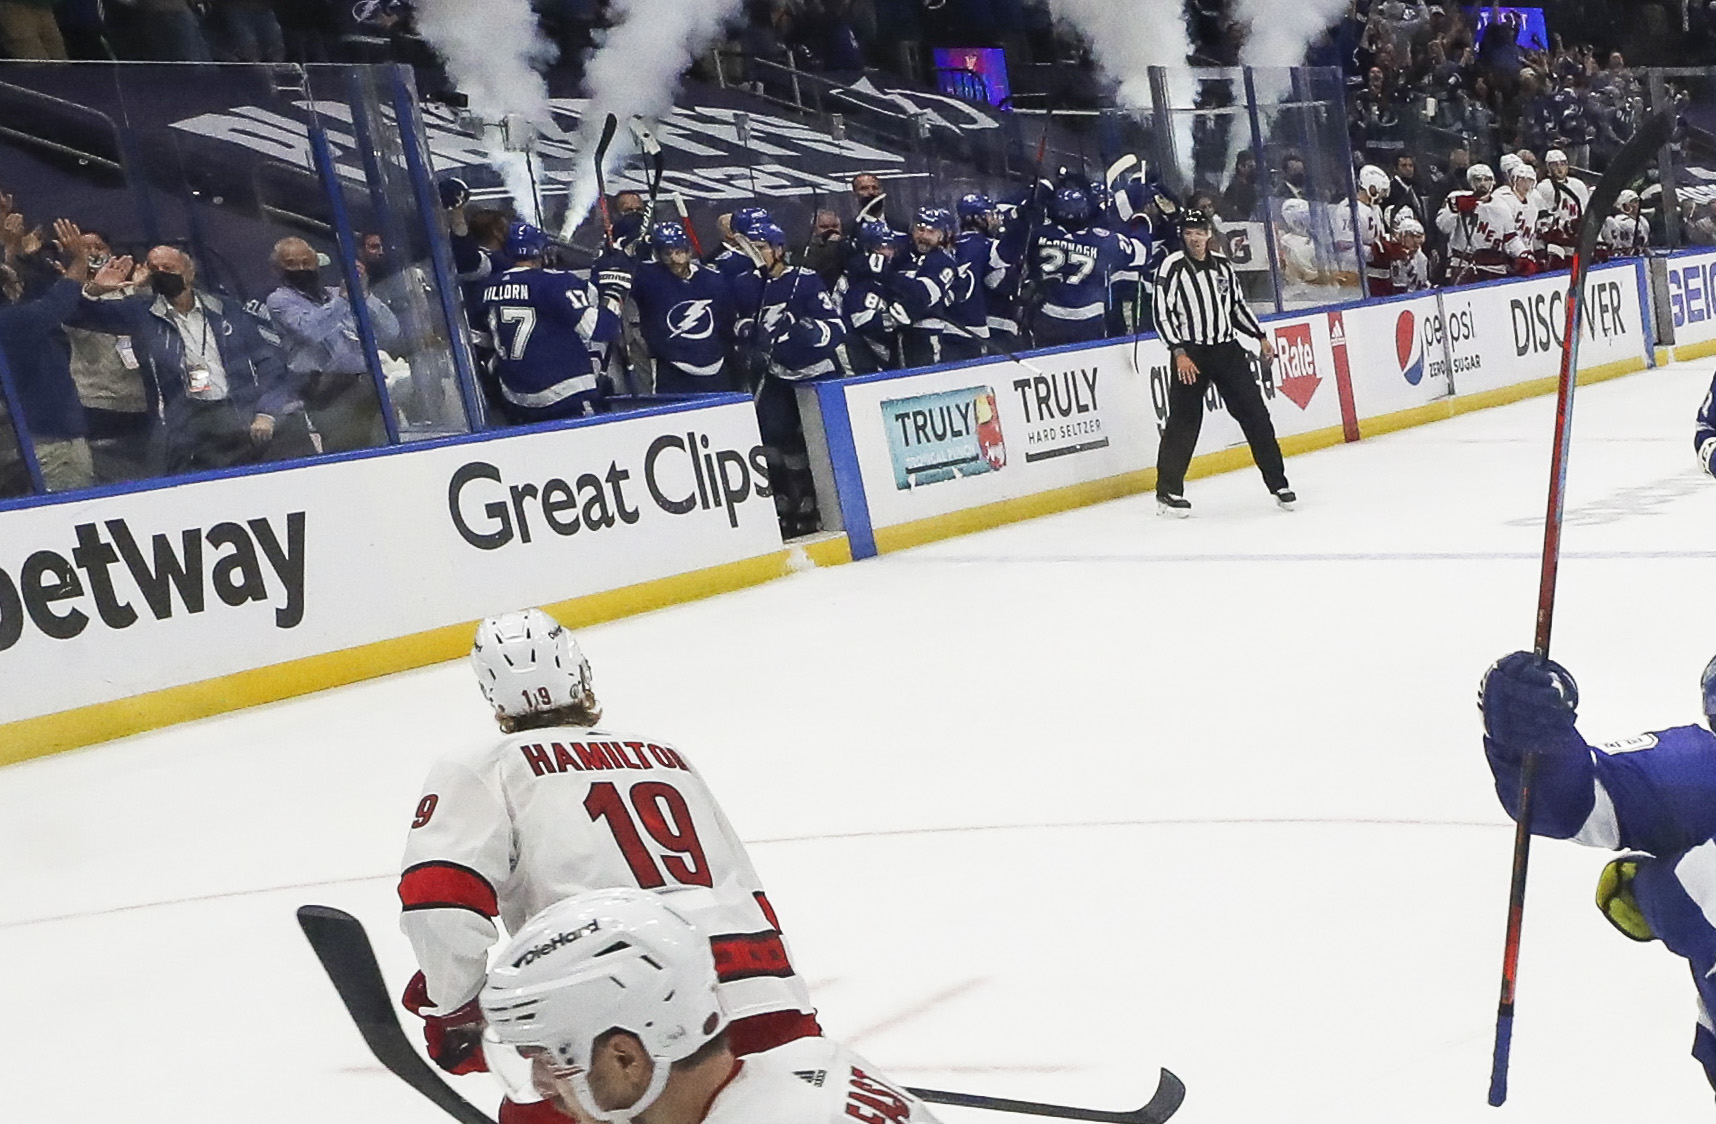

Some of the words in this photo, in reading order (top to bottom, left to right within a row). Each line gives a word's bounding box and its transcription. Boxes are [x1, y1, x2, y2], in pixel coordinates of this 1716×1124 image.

[1040, 246, 1095, 285] 27
[1424, 302, 1474, 357] pepsi
[1510, 281, 1626, 357] DISCVER
[1277, 336, 1314, 379] Rate
[1454, 354, 1481, 374] SUGAR
[1013, 367, 1098, 423] TRULY
[895, 402, 970, 447] TRULY
[1028, 428, 1056, 444] HARD
[1060, 418, 1102, 438] SELTZER
[448, 460, 640, 550] Great
[645, 432, 774, 528] Clips
[521, 686, 552, 708] 19
[583, 781, 713, 889] 19
[522, 918, 600, 965] DieHard
